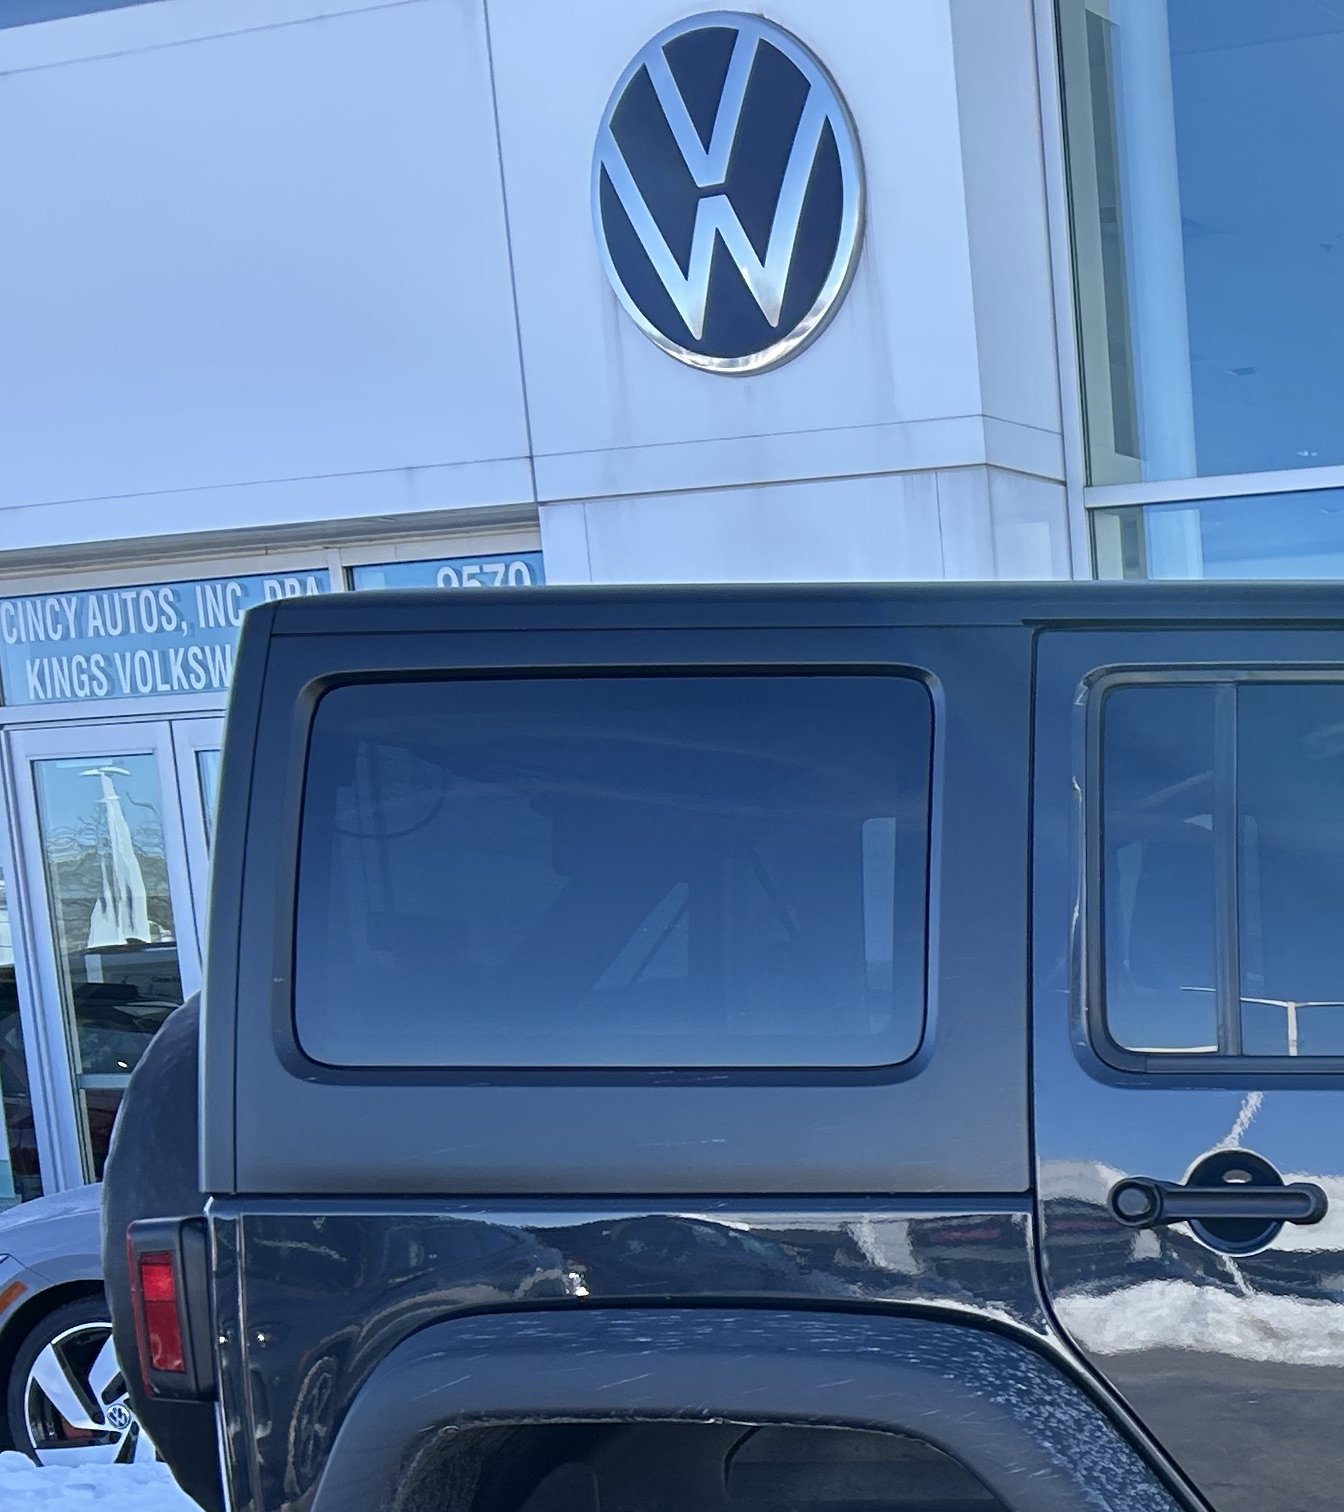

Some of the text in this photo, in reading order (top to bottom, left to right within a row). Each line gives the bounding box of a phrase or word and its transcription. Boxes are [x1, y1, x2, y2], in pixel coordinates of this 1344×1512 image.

[594, 16, 854, 358] VW
[2, 597, 77, 644] CINCY
[88, 587, 187, 637] AUTOS,
[26, 653, 108, 700] KINGS
